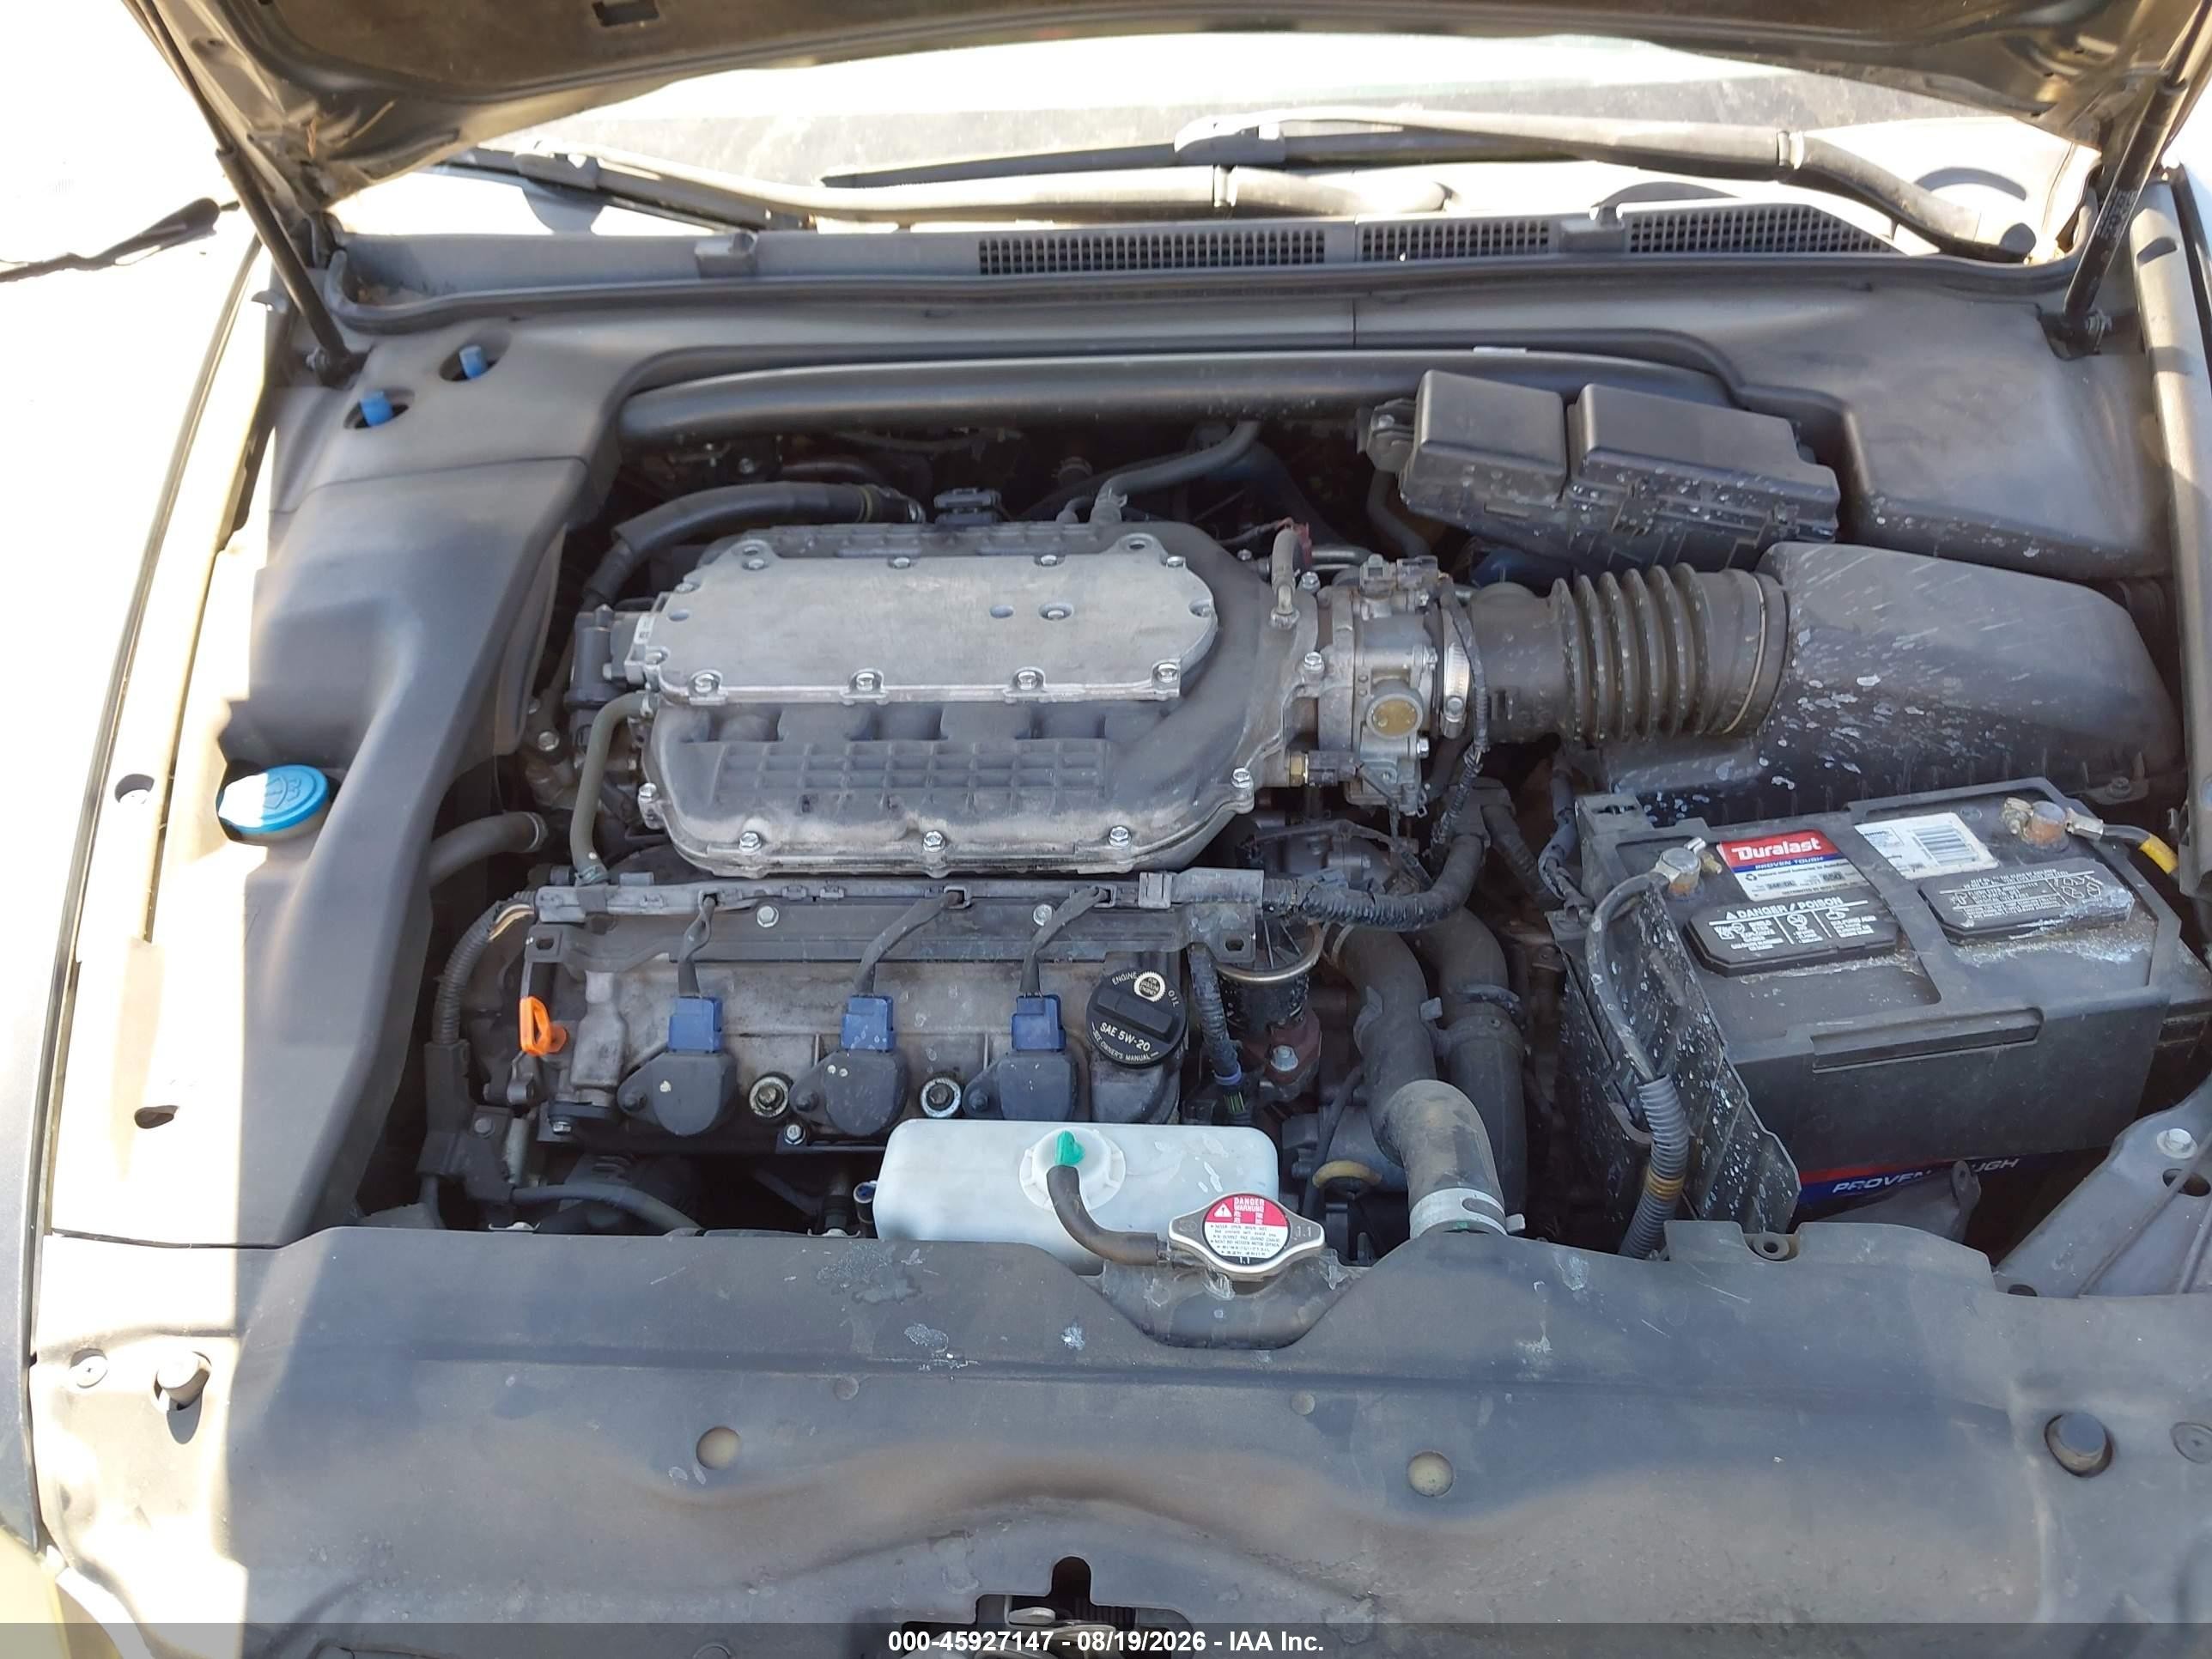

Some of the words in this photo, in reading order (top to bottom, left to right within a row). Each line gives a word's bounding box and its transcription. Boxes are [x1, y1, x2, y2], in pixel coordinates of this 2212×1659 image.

[1731, 837, 1822, 860] Duralast
[1755, 860, 1791, 870] PROVEN
[1794, 856, 1824, 865] TOUGH
[1736, 905, 1788, 919] DANGER
[1797, 896, 1844, 909] POISON
[1111, 971, 1138, 986] ENGINE
[1168, 989, 1181, 1008] OIL
[1100, 1022, 1118, 1037] SAE
[1118, 1030, 1151, 1052] 5W-20
[1100, 1040, 1124, 1060] OWNER'S
[1125, 1053, 1151, 1062] MANUAL
[1972, 1158, 2020, 1173] UGH
[1234, 1197, 1265, 1206] DANGER
[1239, 1255, 1250, 1265] 1.1
